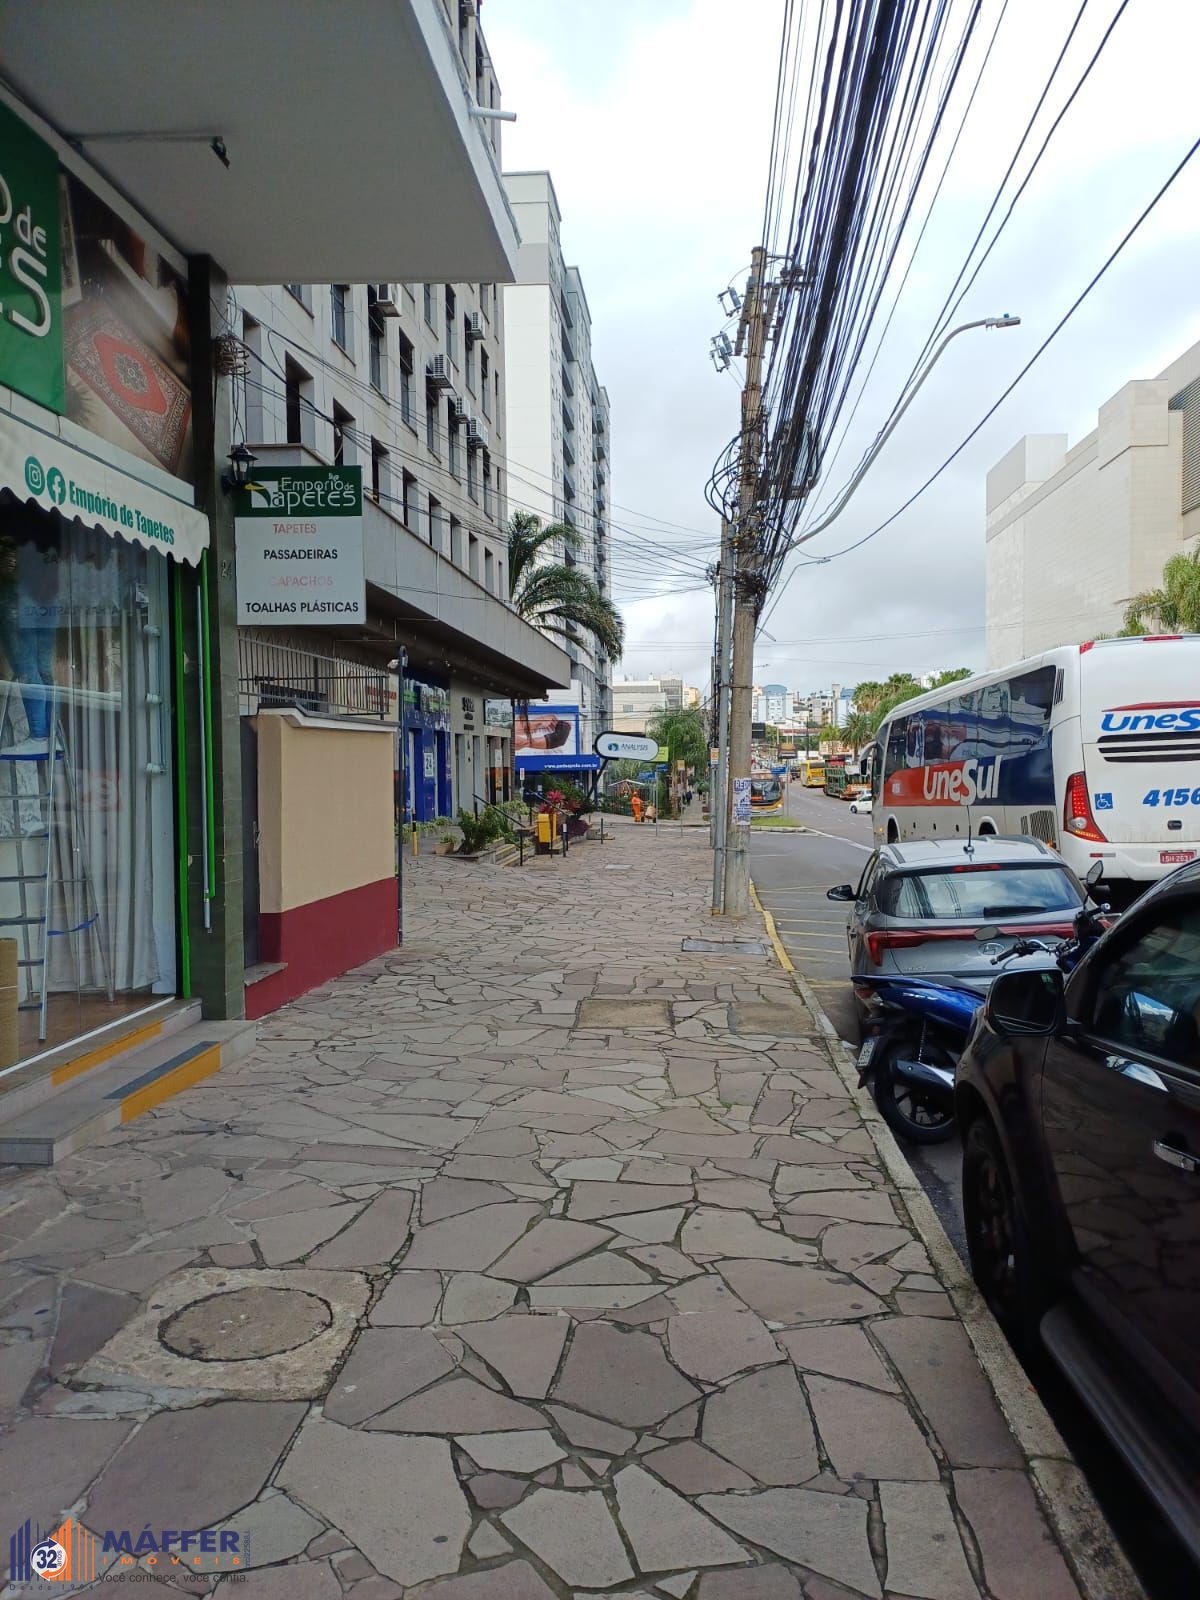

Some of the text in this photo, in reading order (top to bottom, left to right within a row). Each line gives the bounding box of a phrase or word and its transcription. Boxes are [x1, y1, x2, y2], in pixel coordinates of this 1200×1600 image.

[69, 480, 175, 546] Empório de Tapetes
[273, 523, 317, 534] TAPETES
[263, 549, 338, 560] PASSADEIRAS
[271, 576, 333, 587] CAPACHOS
[245, 599, 359, 613] TOALHAS PLÁSTICAS
[620, 742, 648, 752] ANALYSIS
[1142, 787, 1200, 807] 4156
